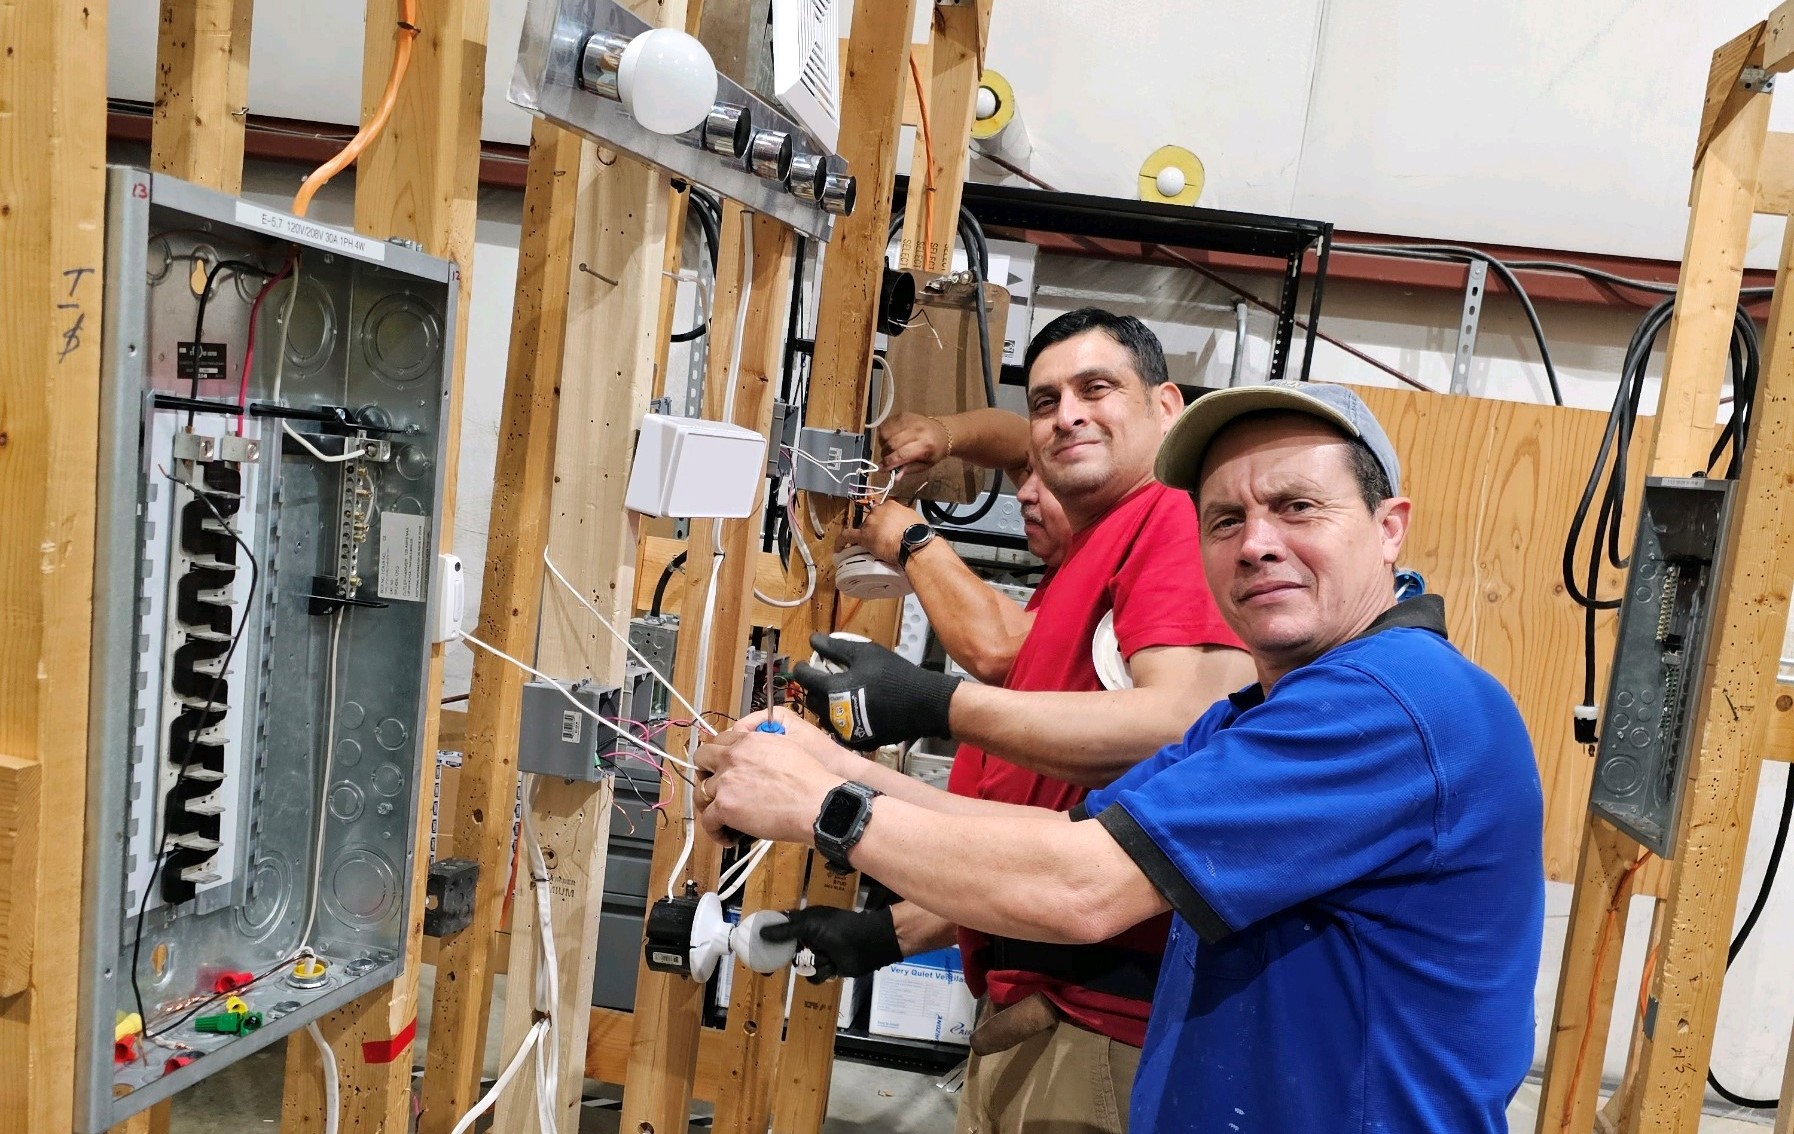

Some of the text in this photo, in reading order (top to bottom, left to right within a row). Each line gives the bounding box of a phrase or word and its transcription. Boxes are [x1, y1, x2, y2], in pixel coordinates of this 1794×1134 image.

[131, 183, 148, 199] 13
[325, 232, 338, 244] 30A
[340, 236, 353, 248] 1PH
[355, 241, 366, 251] 4W
[900, 238, 912, 268] SELECT
[890, 966, 908, 977] Very
[911, 969, 933, 979] Quiet
